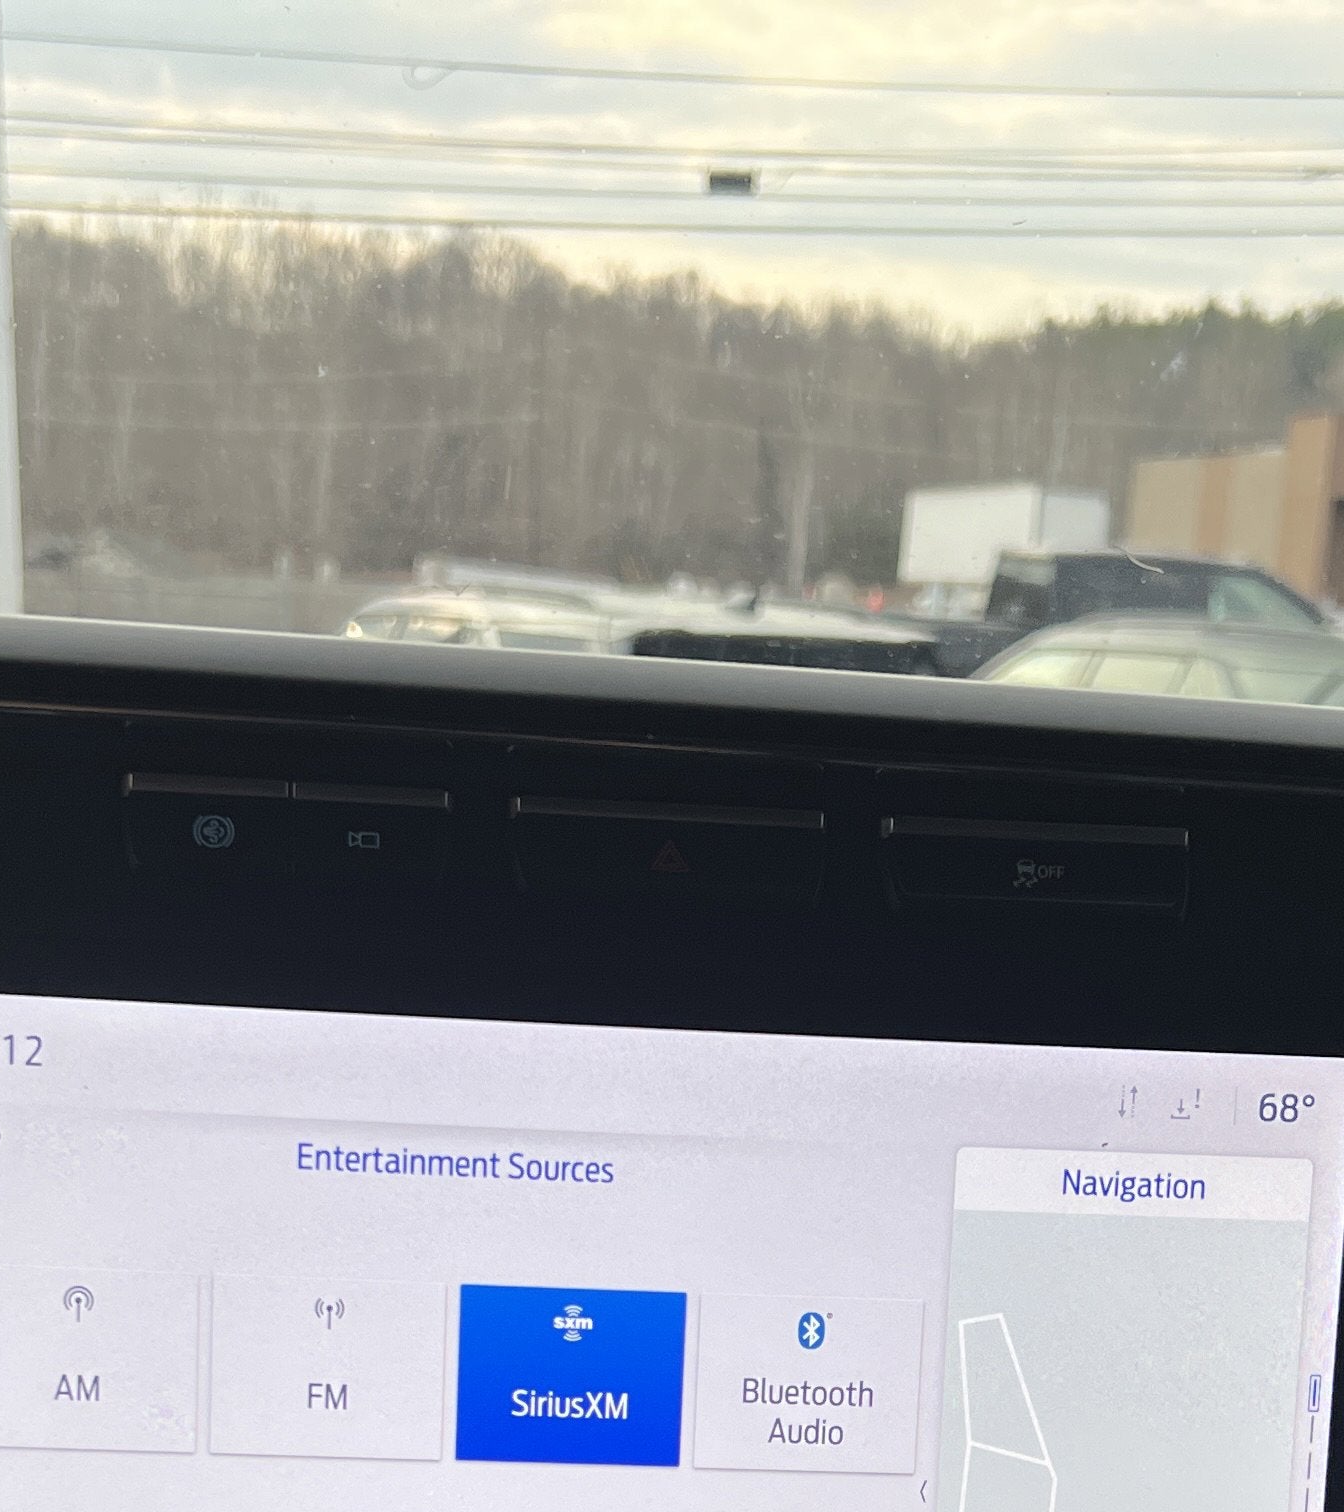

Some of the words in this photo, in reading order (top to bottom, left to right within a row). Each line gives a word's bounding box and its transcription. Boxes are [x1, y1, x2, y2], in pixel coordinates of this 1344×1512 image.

[1038, 864, 1065, 880] OFF
[1257, 1093, 1316, 1123] 68°
[296, 1143, 500, 1179] Entertainment
[508, 1153, 614, 1183] Sources
[1061, 1169, 1206, 1202] Navigation
[54, 1375, 101, 1402] AM
[306, 1384, 348, 1411] FM
[742, 1378, 874, 1408] Bluetooth
[510, 1389, 628, 1420] SiriusXM
[768, 1418, 844, 1446] Audio
